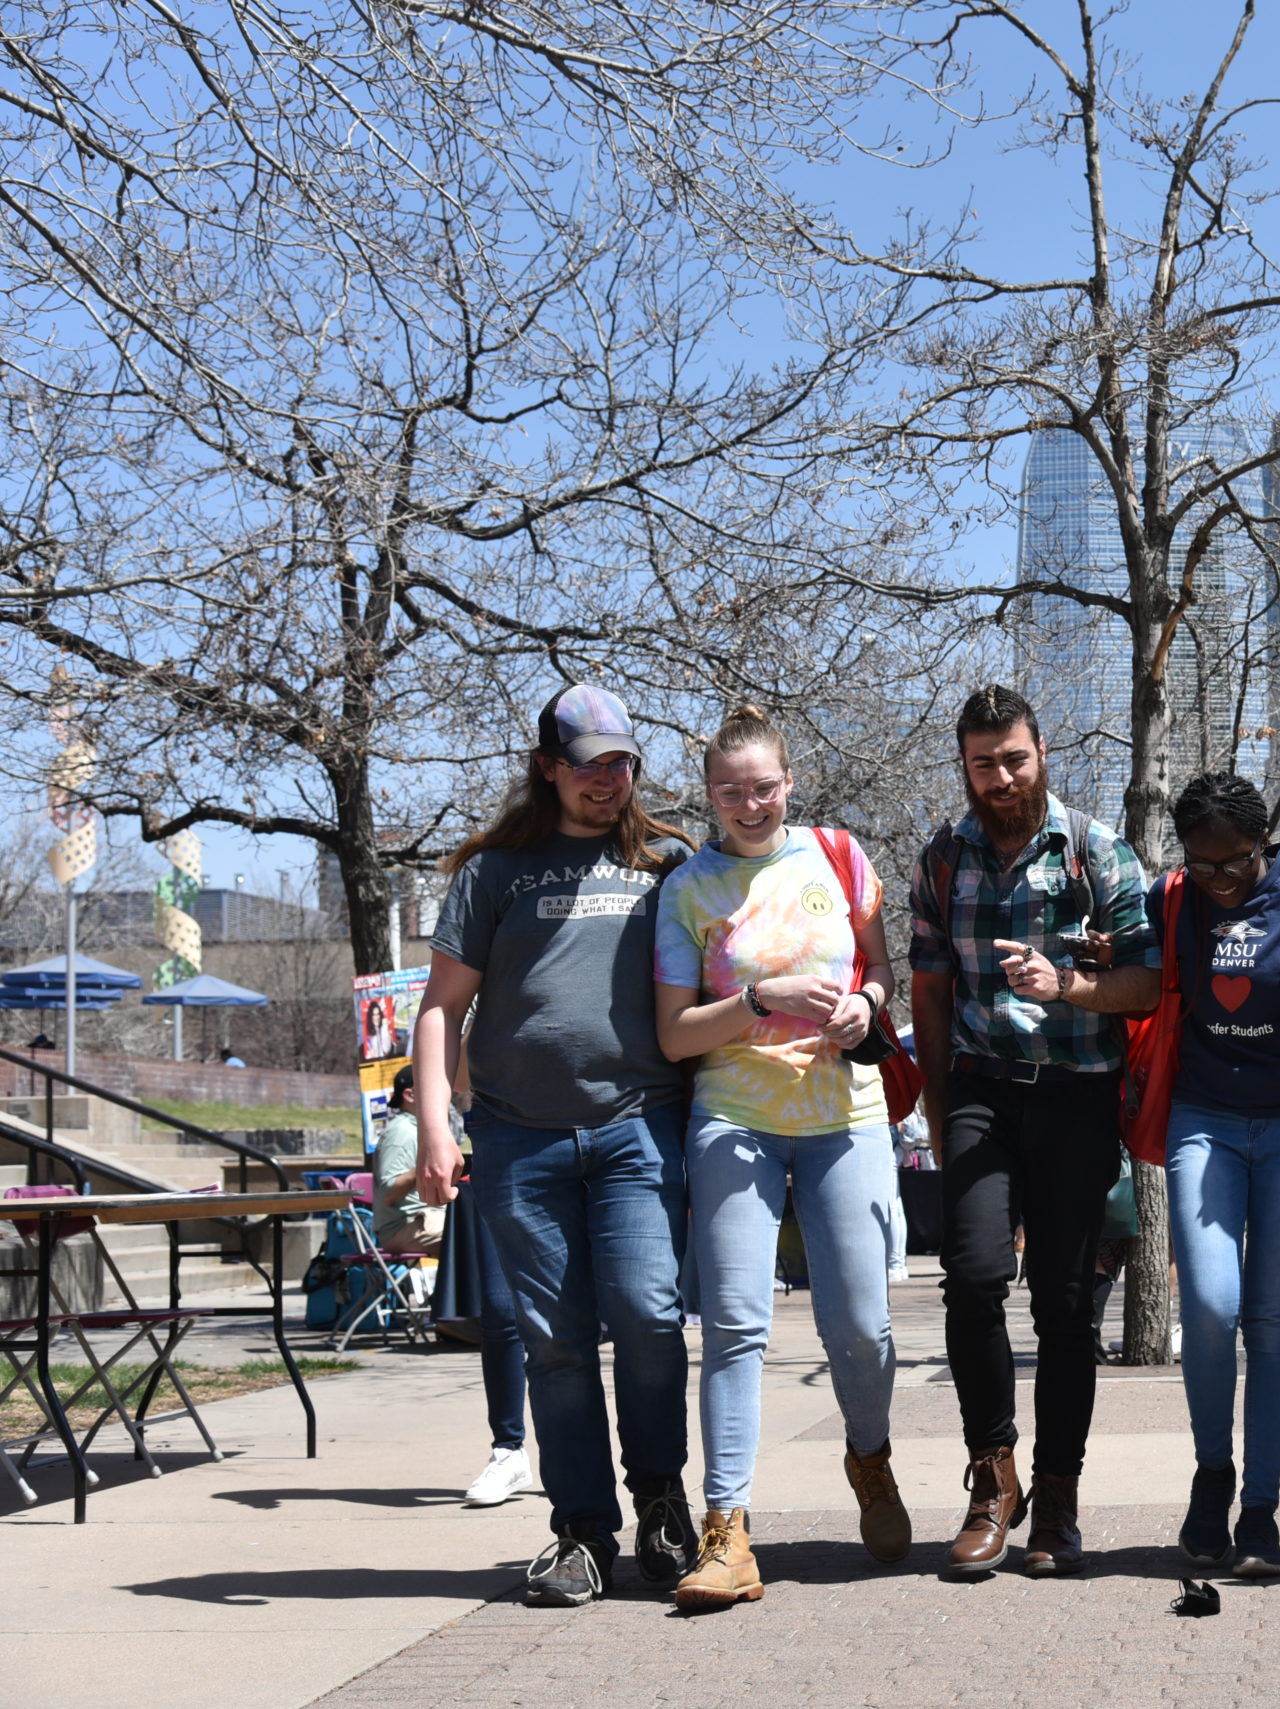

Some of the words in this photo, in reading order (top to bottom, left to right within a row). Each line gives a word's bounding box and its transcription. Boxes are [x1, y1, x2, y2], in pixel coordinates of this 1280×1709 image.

[504, 864, 660, 898] TEAMWOR
[566, 899, 584, 907] LOT
[588, 897, 601, 905] OF
[604, 896, 641, 905] PEOPLE
[546, 907, 577, 916] DOING
[582, 904, 607, 915] WHAT
[618, 905, 636, 913] SAY
[1214, 942, 1258, 957] MSU
[1211, 957, 1255, 968] DENVER
[1230, 1023, 1274, 1037] Students
